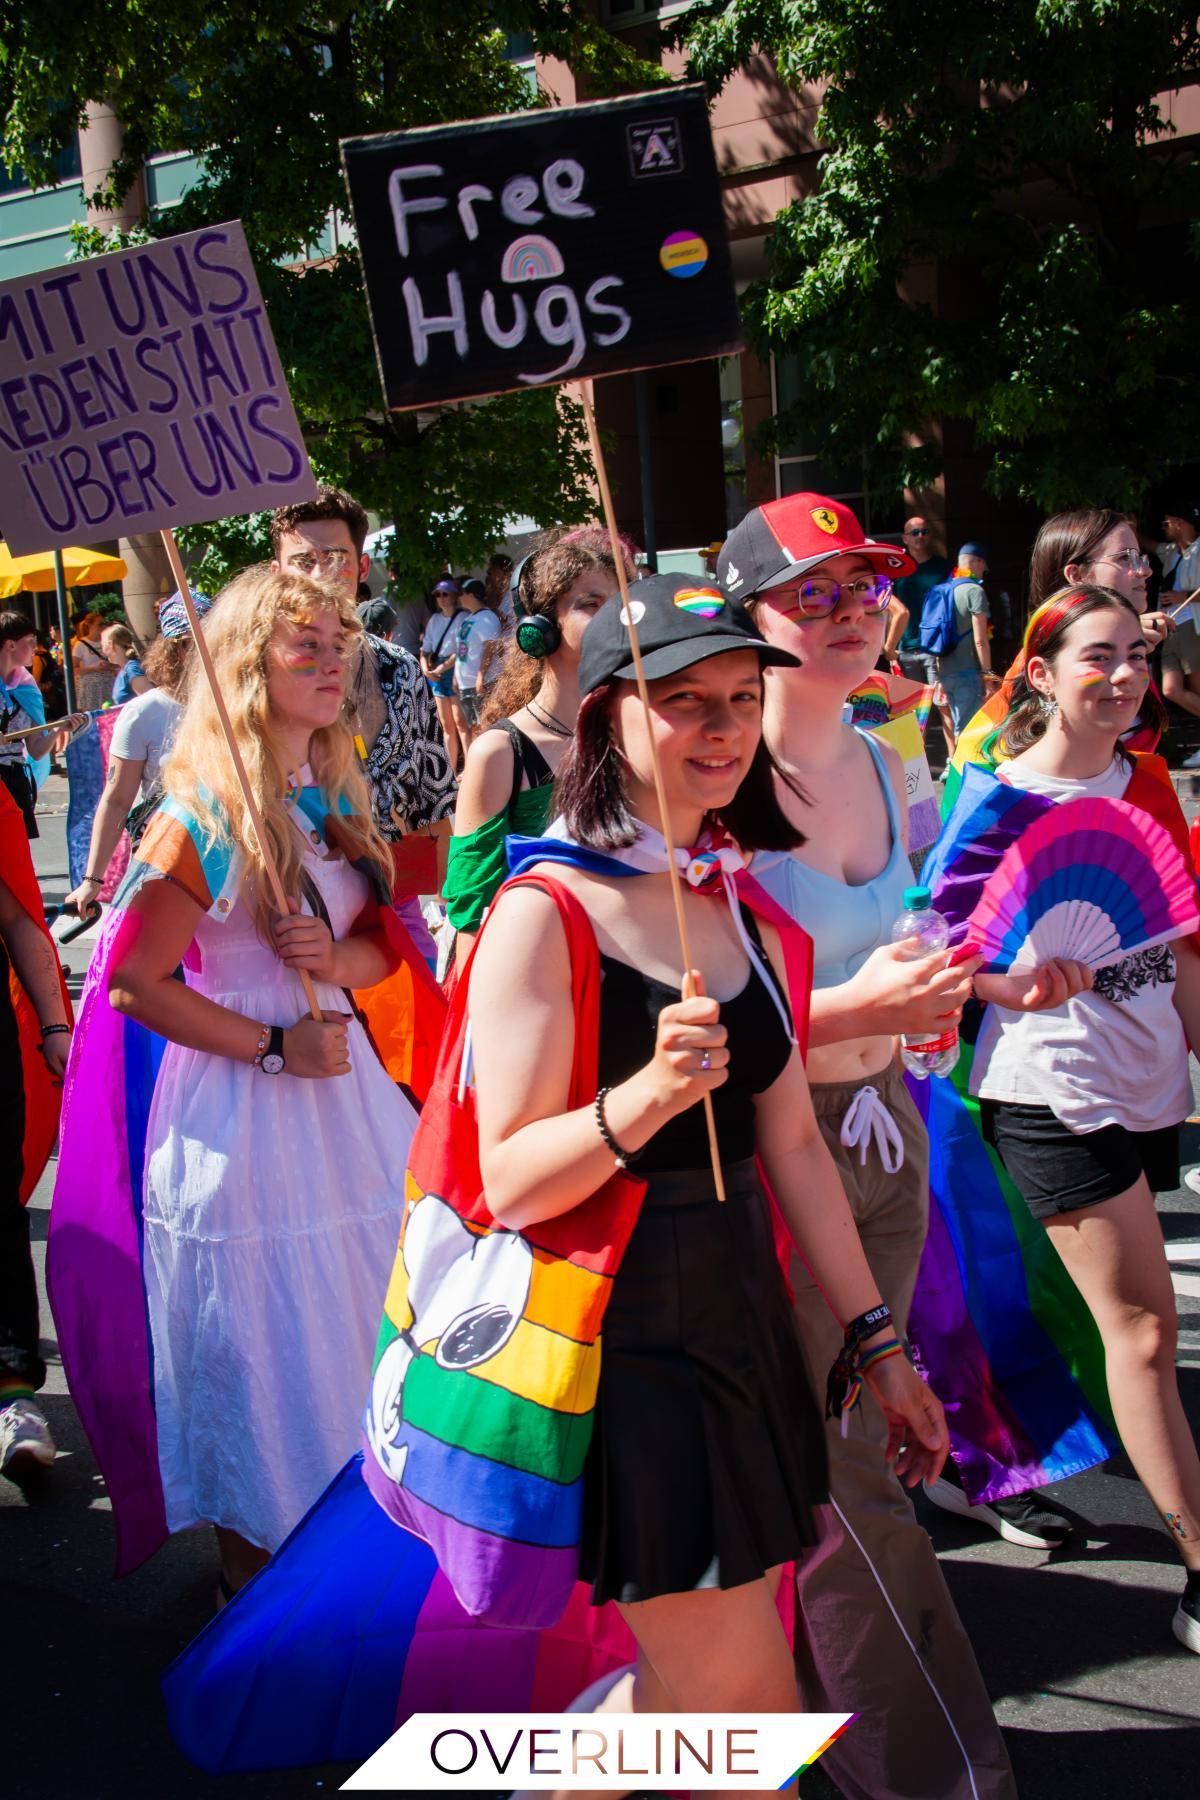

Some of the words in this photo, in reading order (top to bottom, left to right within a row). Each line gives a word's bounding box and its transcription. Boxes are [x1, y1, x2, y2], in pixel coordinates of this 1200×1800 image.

[388, 158, 596, 258] Free
[97, 232, 249, 336] UNS
[402, 270, 632, 383] Hugs
[0, 347, 139, 450] EDEN
[135, 305, 276, 413] STATT
[21, 430, 176, 532] ÜBER
[169, 394, 303, 496] UNS
